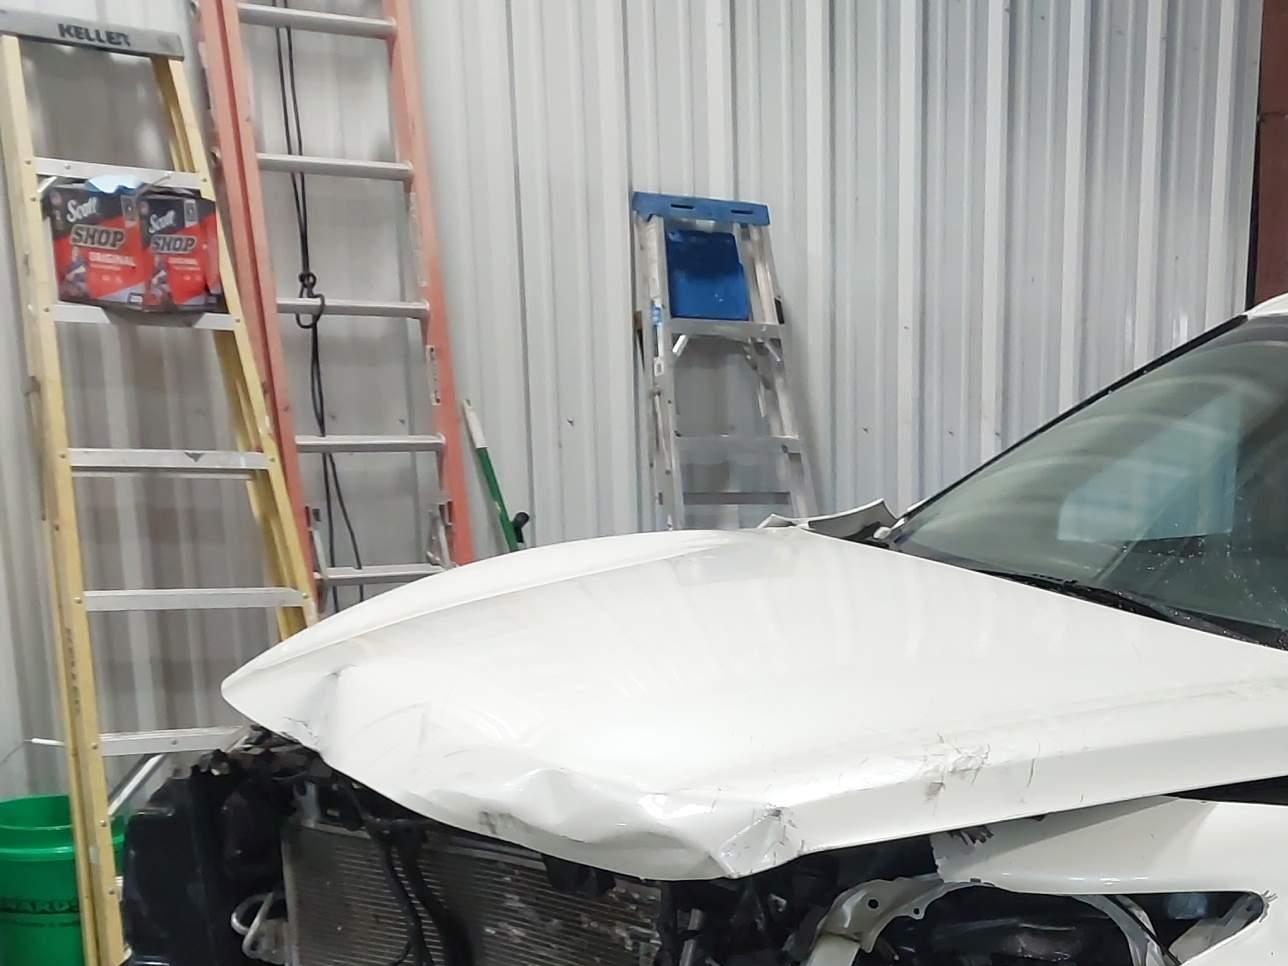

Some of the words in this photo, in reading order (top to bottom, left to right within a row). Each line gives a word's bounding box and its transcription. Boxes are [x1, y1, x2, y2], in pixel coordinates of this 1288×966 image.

[58, 23, 131, 47] KELLER
[72, 226, 124, 248] SHOP
[152, 236, 196, 251] SHOP
